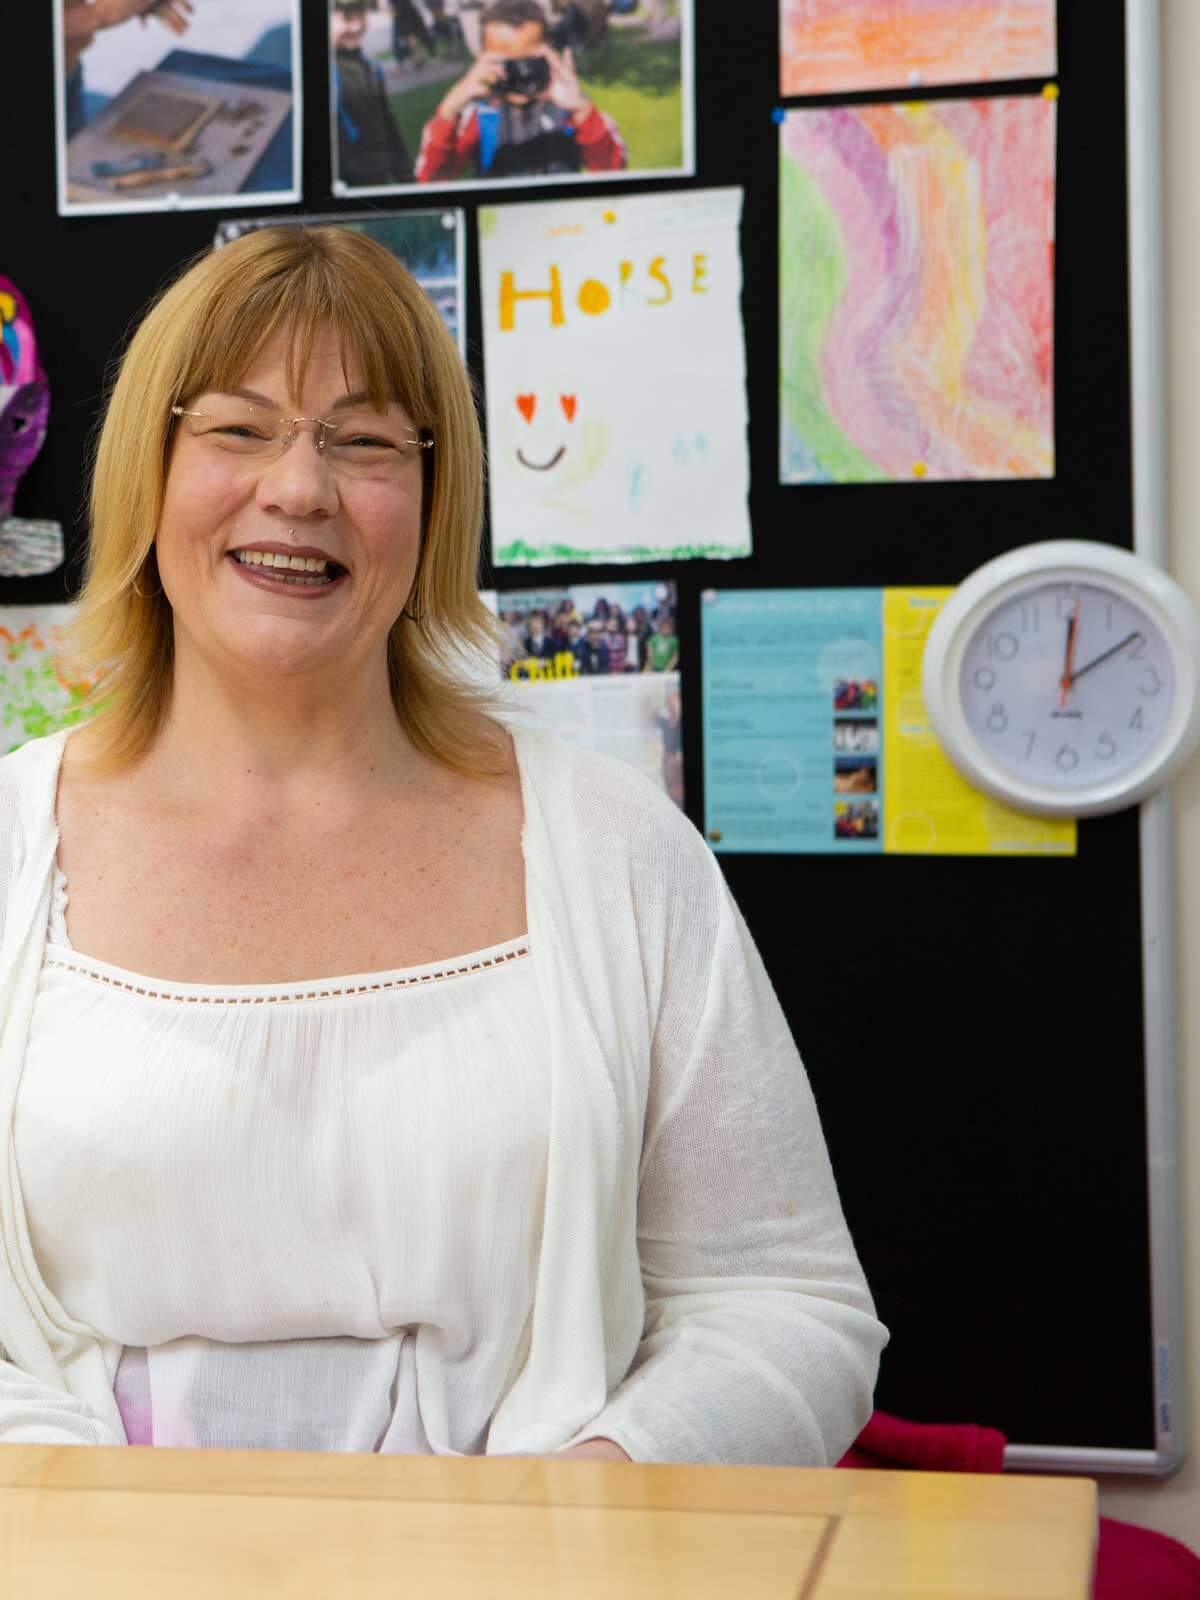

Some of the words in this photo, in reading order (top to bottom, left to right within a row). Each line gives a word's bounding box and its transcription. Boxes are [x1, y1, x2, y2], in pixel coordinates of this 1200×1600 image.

[1021, 605, 1039, 631] 11
[1105, 604, 1113, 629] 1
[987, 631, 1019, 662] 10
[1127, 632, 1147, 660] 2
[973, 667, 995, 693] 9
[1137, 665, 1162, 697] 3
[986, 702, 1008, 733] 8
[1128, 706, 1145, 731] 4
[1023, 731, 1037, 758] 7
[1055, 744, 1079, 771] 6
[1095, 730, 1118, 760] 5
